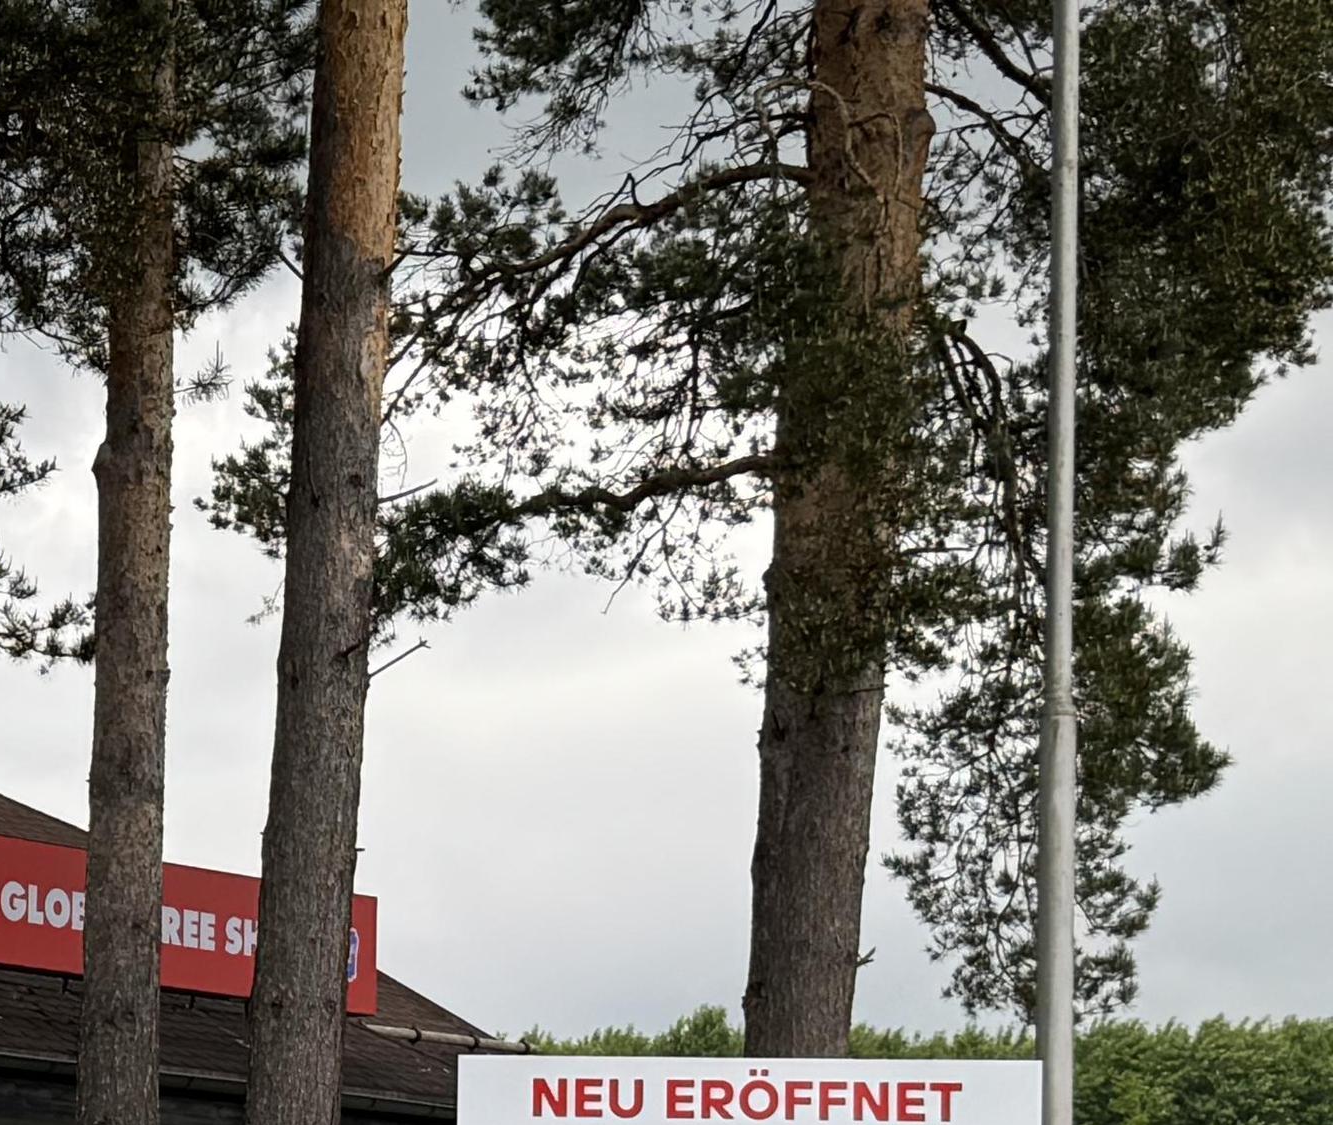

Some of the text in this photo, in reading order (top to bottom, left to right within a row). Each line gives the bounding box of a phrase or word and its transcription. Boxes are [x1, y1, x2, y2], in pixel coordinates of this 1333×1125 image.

[0, 880, 259, 957] GLOB REE SH
[532, 1068, 963, 1123] NEU ERÖFFNET
